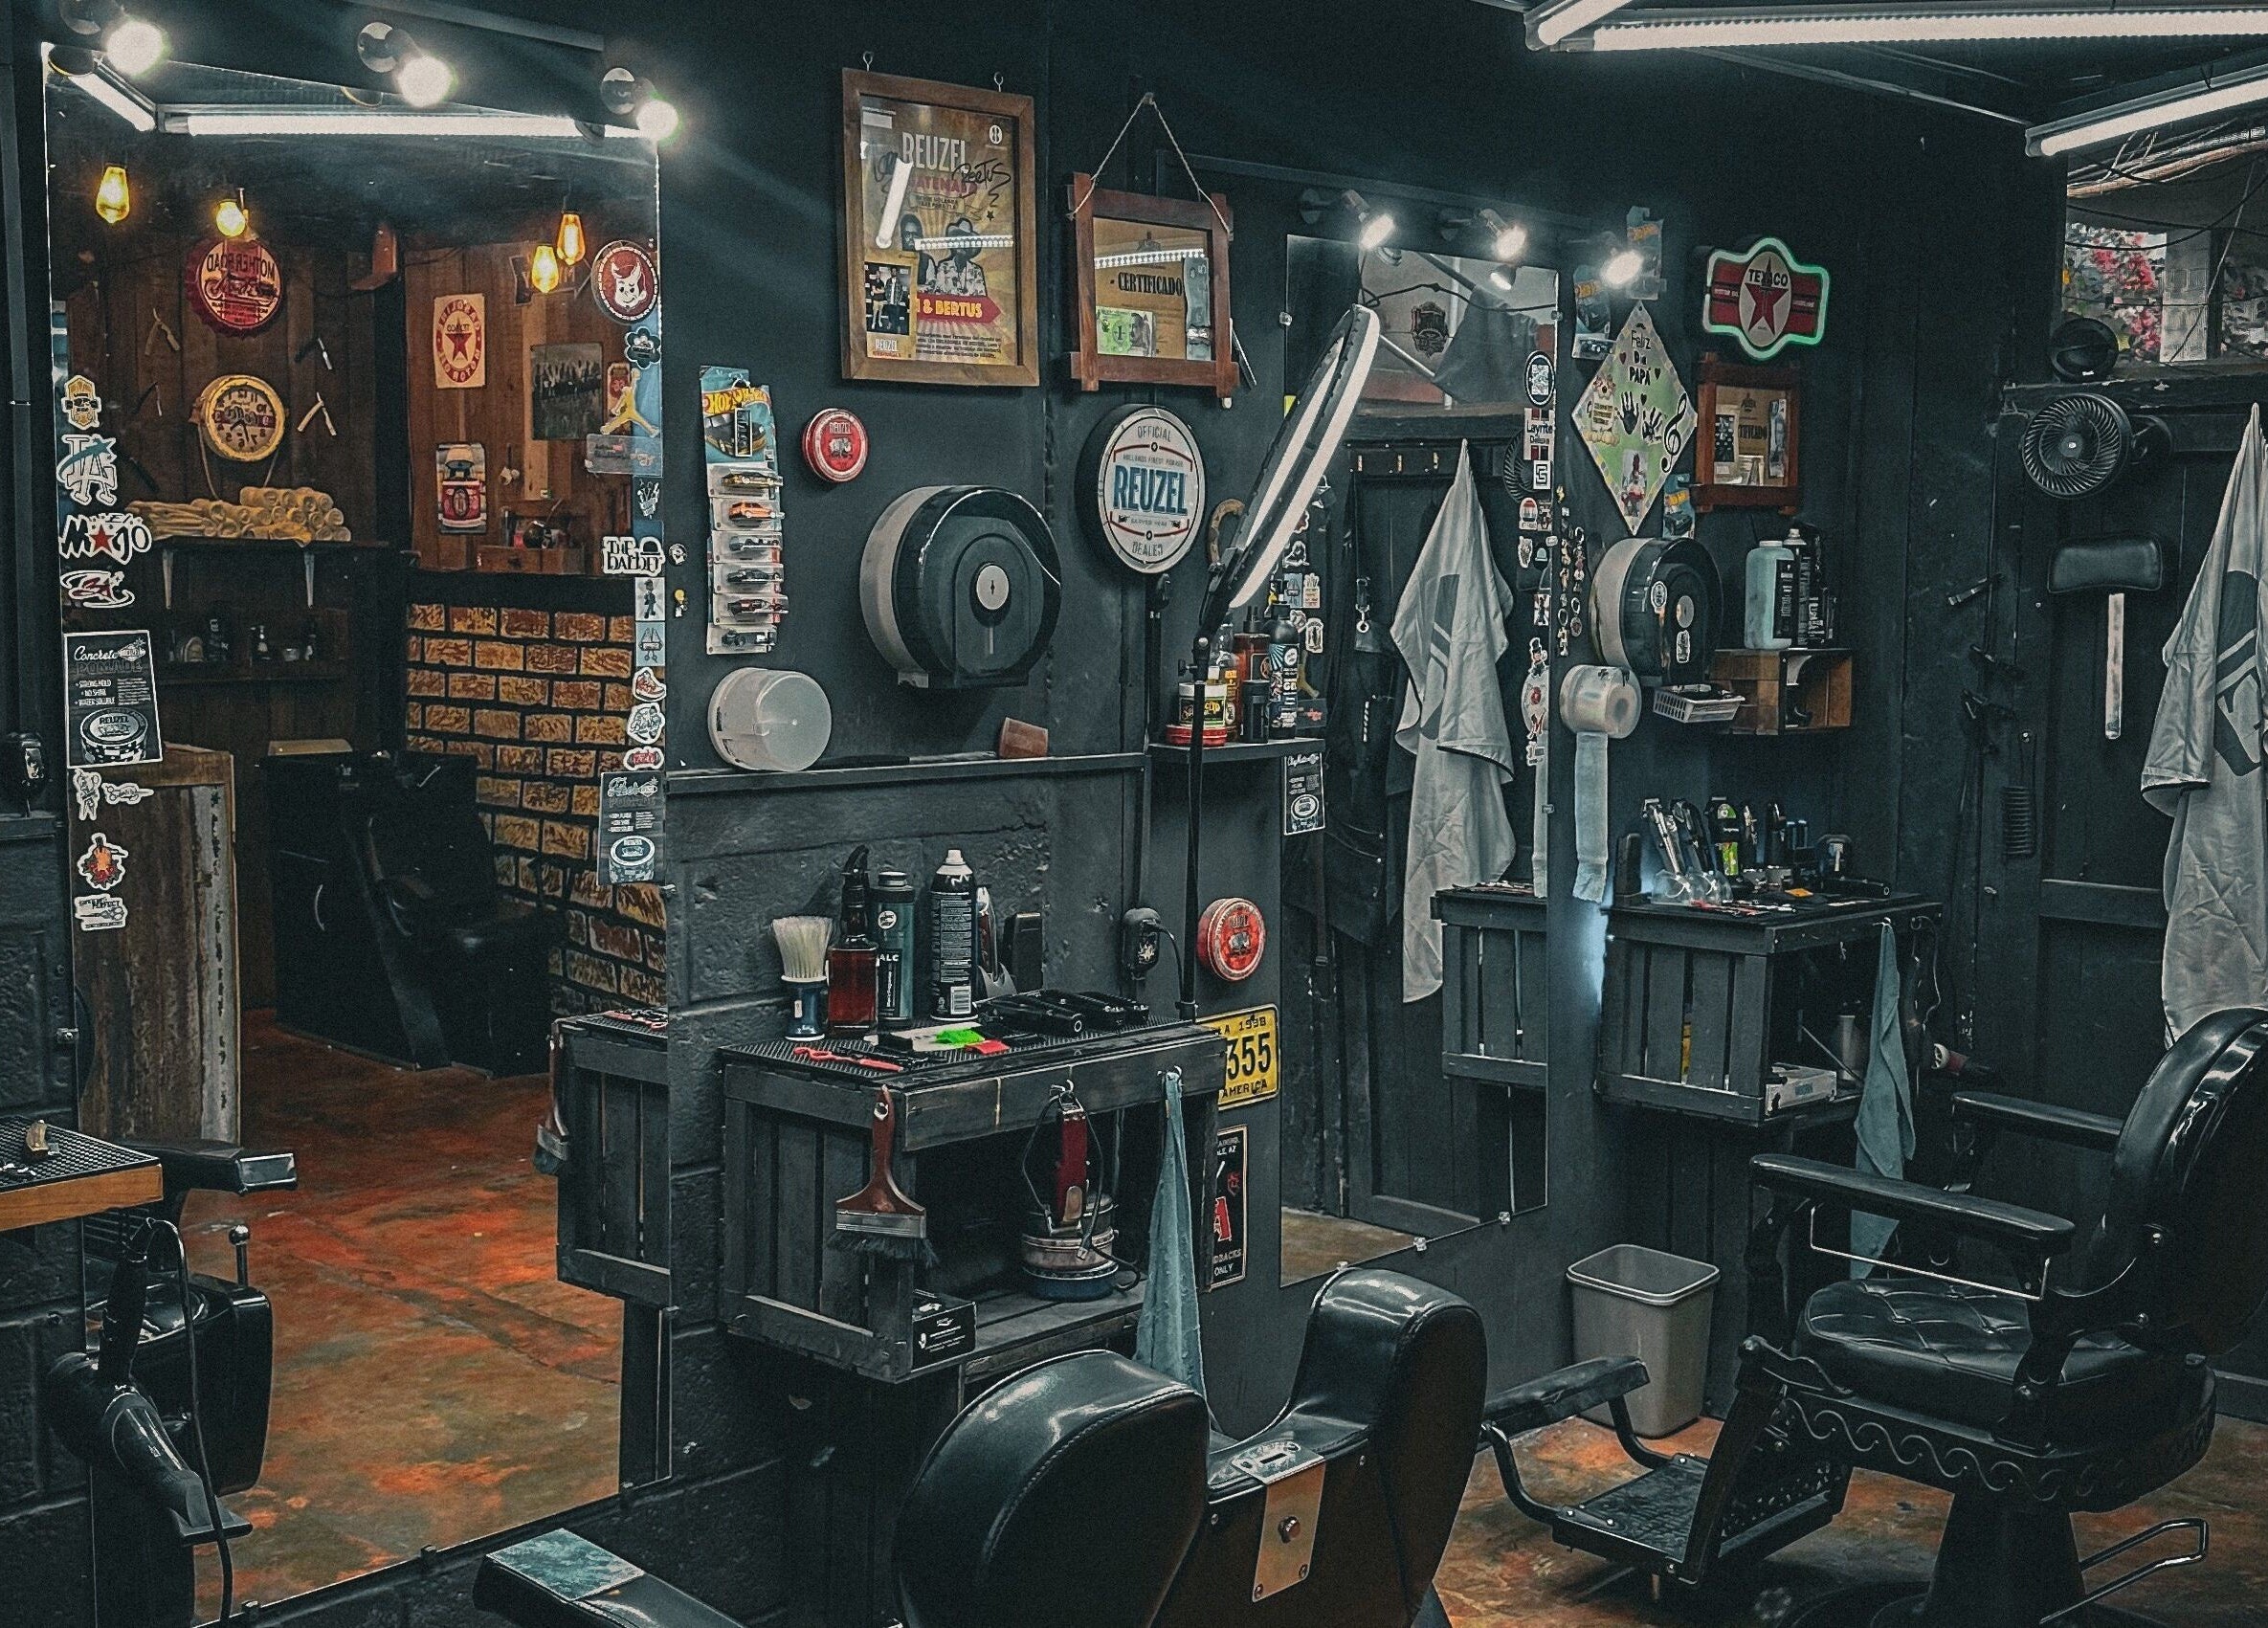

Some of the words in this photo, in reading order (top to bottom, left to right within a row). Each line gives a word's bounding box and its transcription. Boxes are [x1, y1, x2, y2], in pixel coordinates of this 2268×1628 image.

[902, 132, 967, 174] REUZEL
[1118, 272, 1183, 296] CERTIFICADO
[1748, 269, 1789, 287] TEXACO
[935, 301, 983, 318] BERTUS
[1137, 425, 1170, 442] OFFICIAL
[1112, 464, 1188, 516] REUZEL
[1131, 541, 1164, 556] DEALER
[1221, 1078, 1268, 1099] AMERICA
